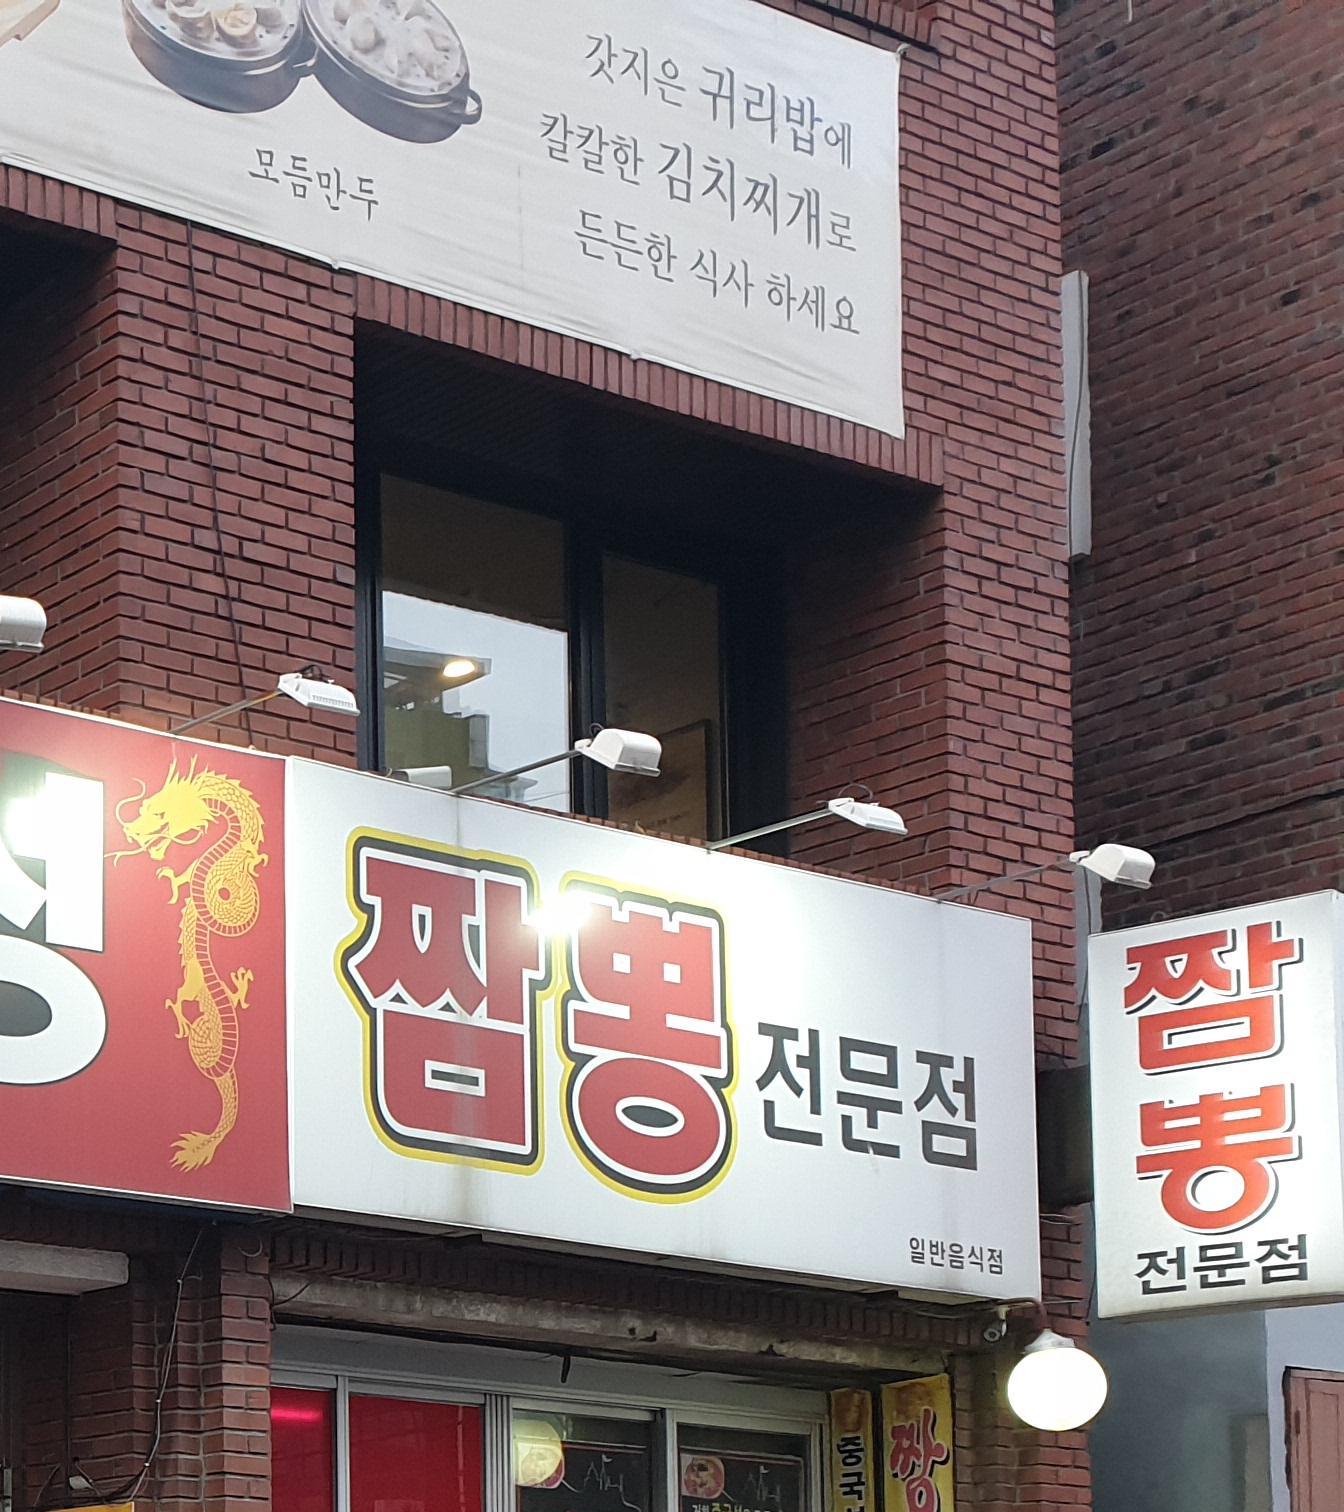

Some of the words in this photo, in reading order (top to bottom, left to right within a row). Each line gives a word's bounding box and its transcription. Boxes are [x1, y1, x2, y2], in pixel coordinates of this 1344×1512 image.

[584, 32, 684, 107] 갓지은
[699, 66, 855, 169] 귀리밥에
[248, 148, 380, 221] 모듬만두
[537, 111, 644, 186] 칼칼한
[657, 141, 858, 253] 김치찌개로
[573, 209, 679, 282] 든든한
[688, 249, 754, 308] 식사
[764, 274, 860, 336] 하세요
[341, 829, 736, 1201] 짬뽕
[755, 1020, 979, 1171] 전문점
[1124, 920, 1303, 1235] 짬뽕
[907, 1236, 1004, 1275] 일반음식점
[1135, 1234, 1309, 1295] 전문점
